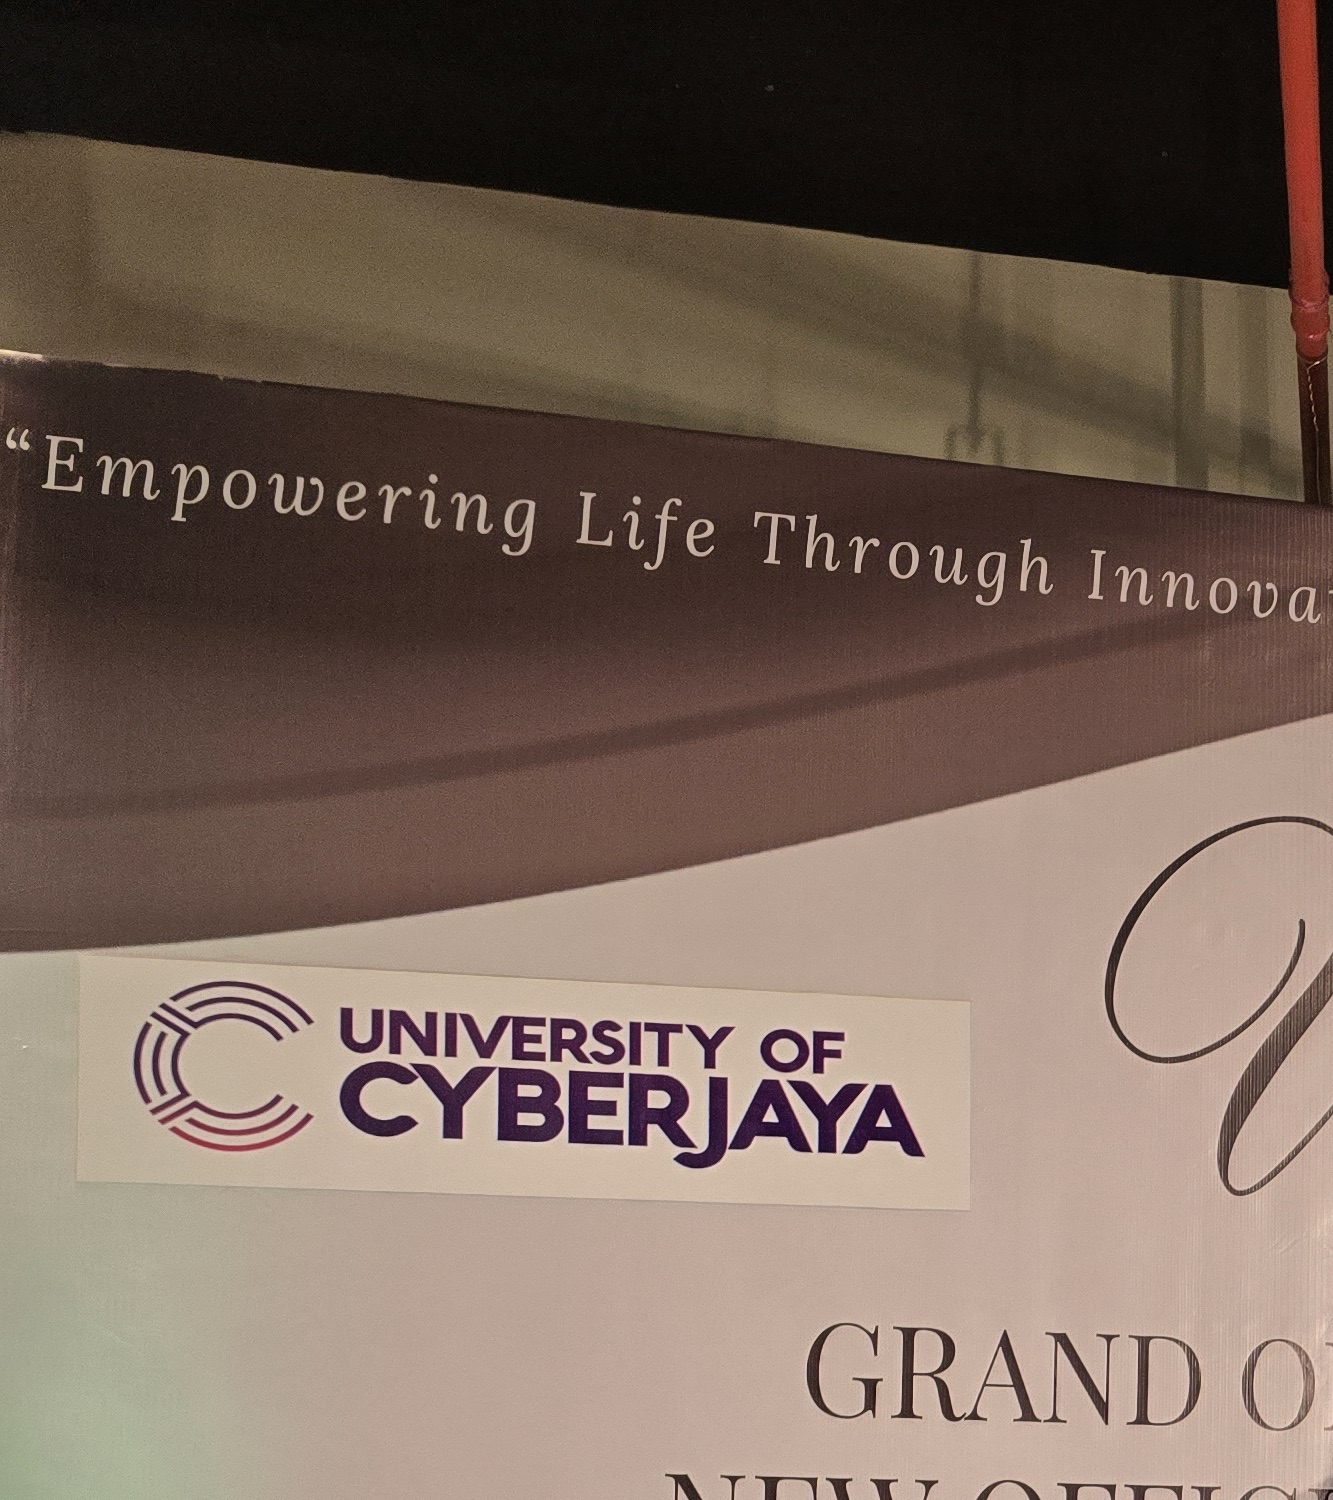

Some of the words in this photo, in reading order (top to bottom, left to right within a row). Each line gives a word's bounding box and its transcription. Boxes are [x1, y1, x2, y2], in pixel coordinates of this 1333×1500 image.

[5, 428, 537, 557] “Empowering
[575, 491, 717, 571] Life
[753, 511, 1055, 606] Through
[339, 1006, 736, 1070] UNIVERSITY
[760, 1028, 845, 1075] OF
[339, 1060, 926, 1170] CYBERJAYA
[805, 1322, 1202, 1426] GRAND
